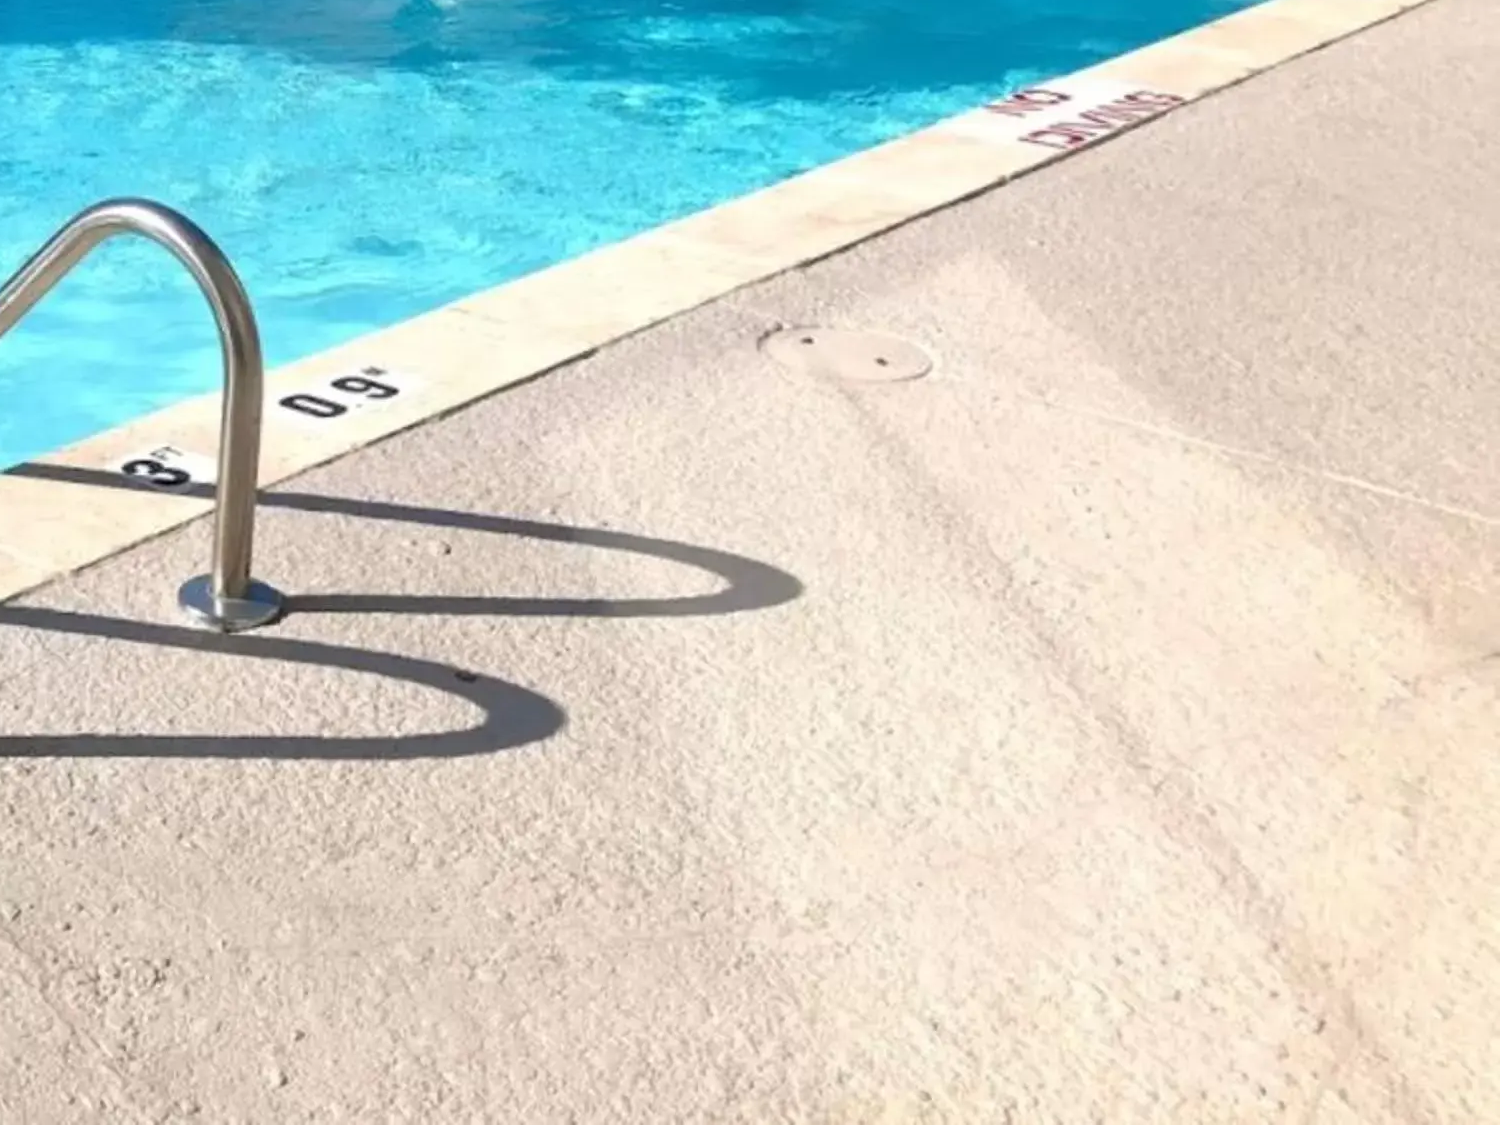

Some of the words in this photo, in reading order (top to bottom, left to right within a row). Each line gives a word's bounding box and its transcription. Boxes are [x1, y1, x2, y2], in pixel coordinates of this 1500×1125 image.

[983, 89, 1073, 119] NO
[1016, 89, 1186, 150] DIVING
[121, 459, 191, 486] 3
